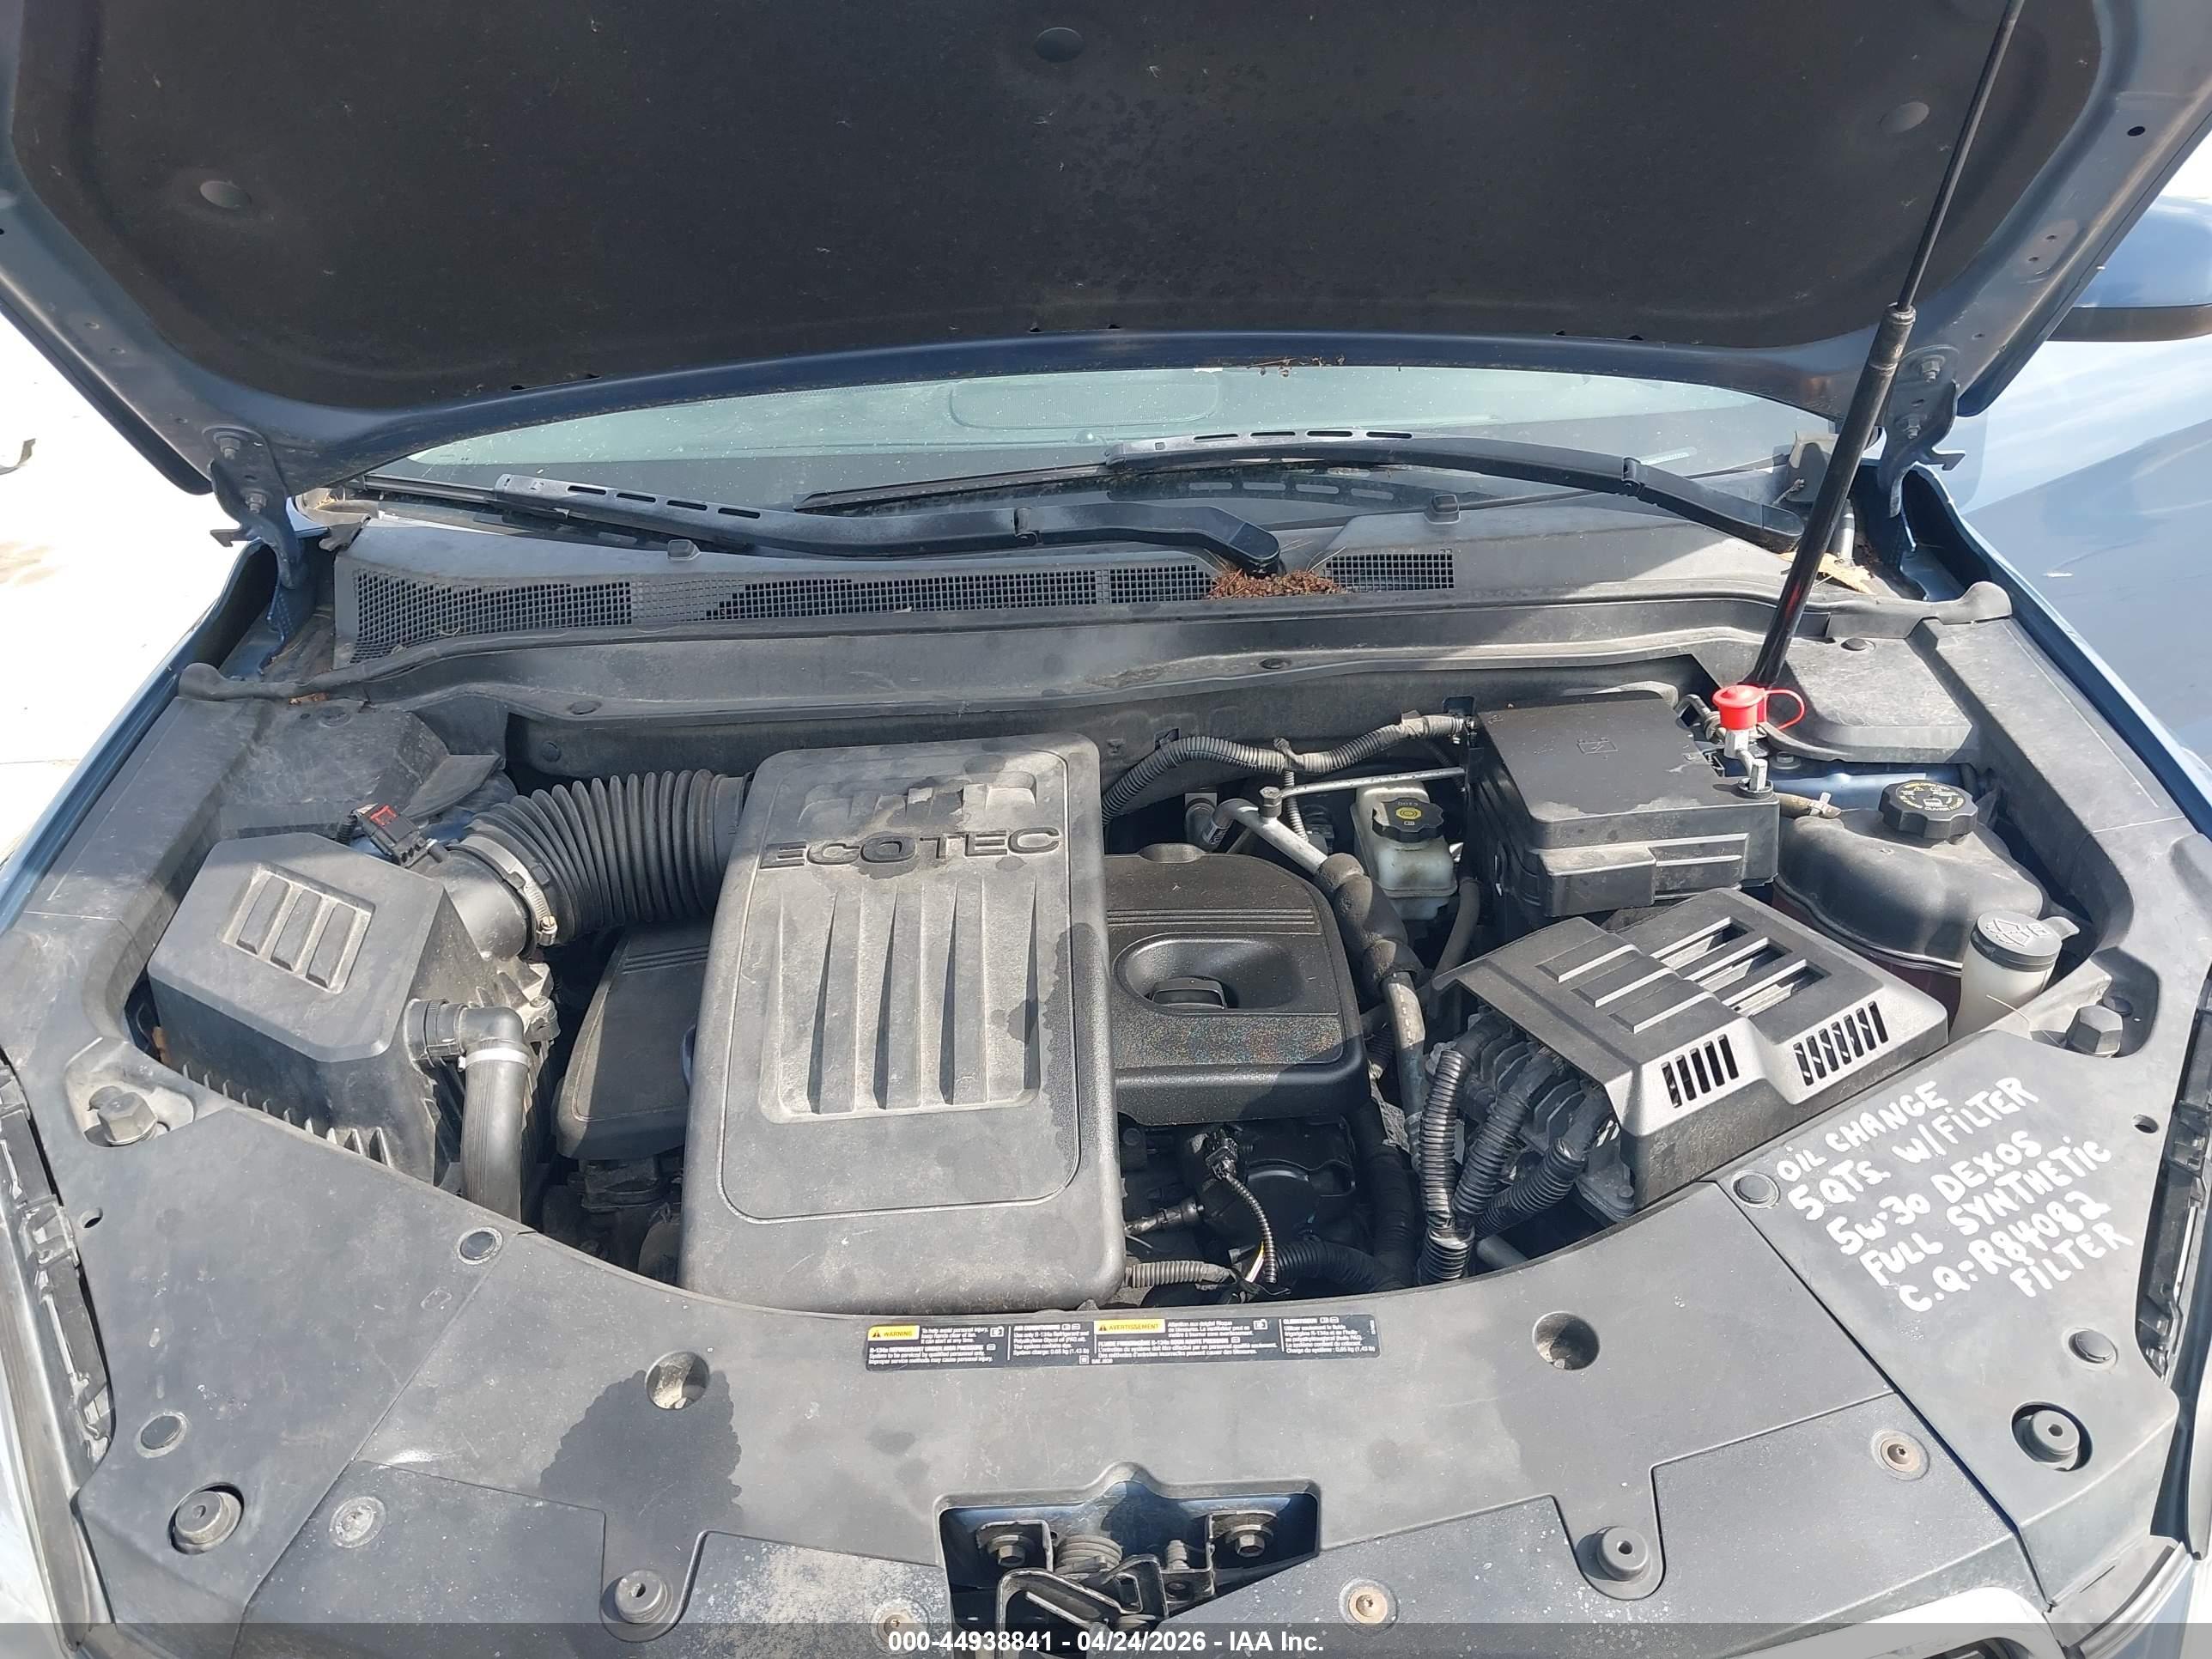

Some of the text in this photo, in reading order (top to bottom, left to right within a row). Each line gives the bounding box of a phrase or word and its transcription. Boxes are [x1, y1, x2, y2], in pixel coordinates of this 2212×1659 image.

[759, 826, 1060, 871] ECOTEC
[1825, 1081, 1948, 1152] CHANGE
[1930, 1131, 2041, 1204] DEXOS
[1859, 1232, 1943, 1288] FULL
[2009, 1222, 2134, 1297] FILTER
